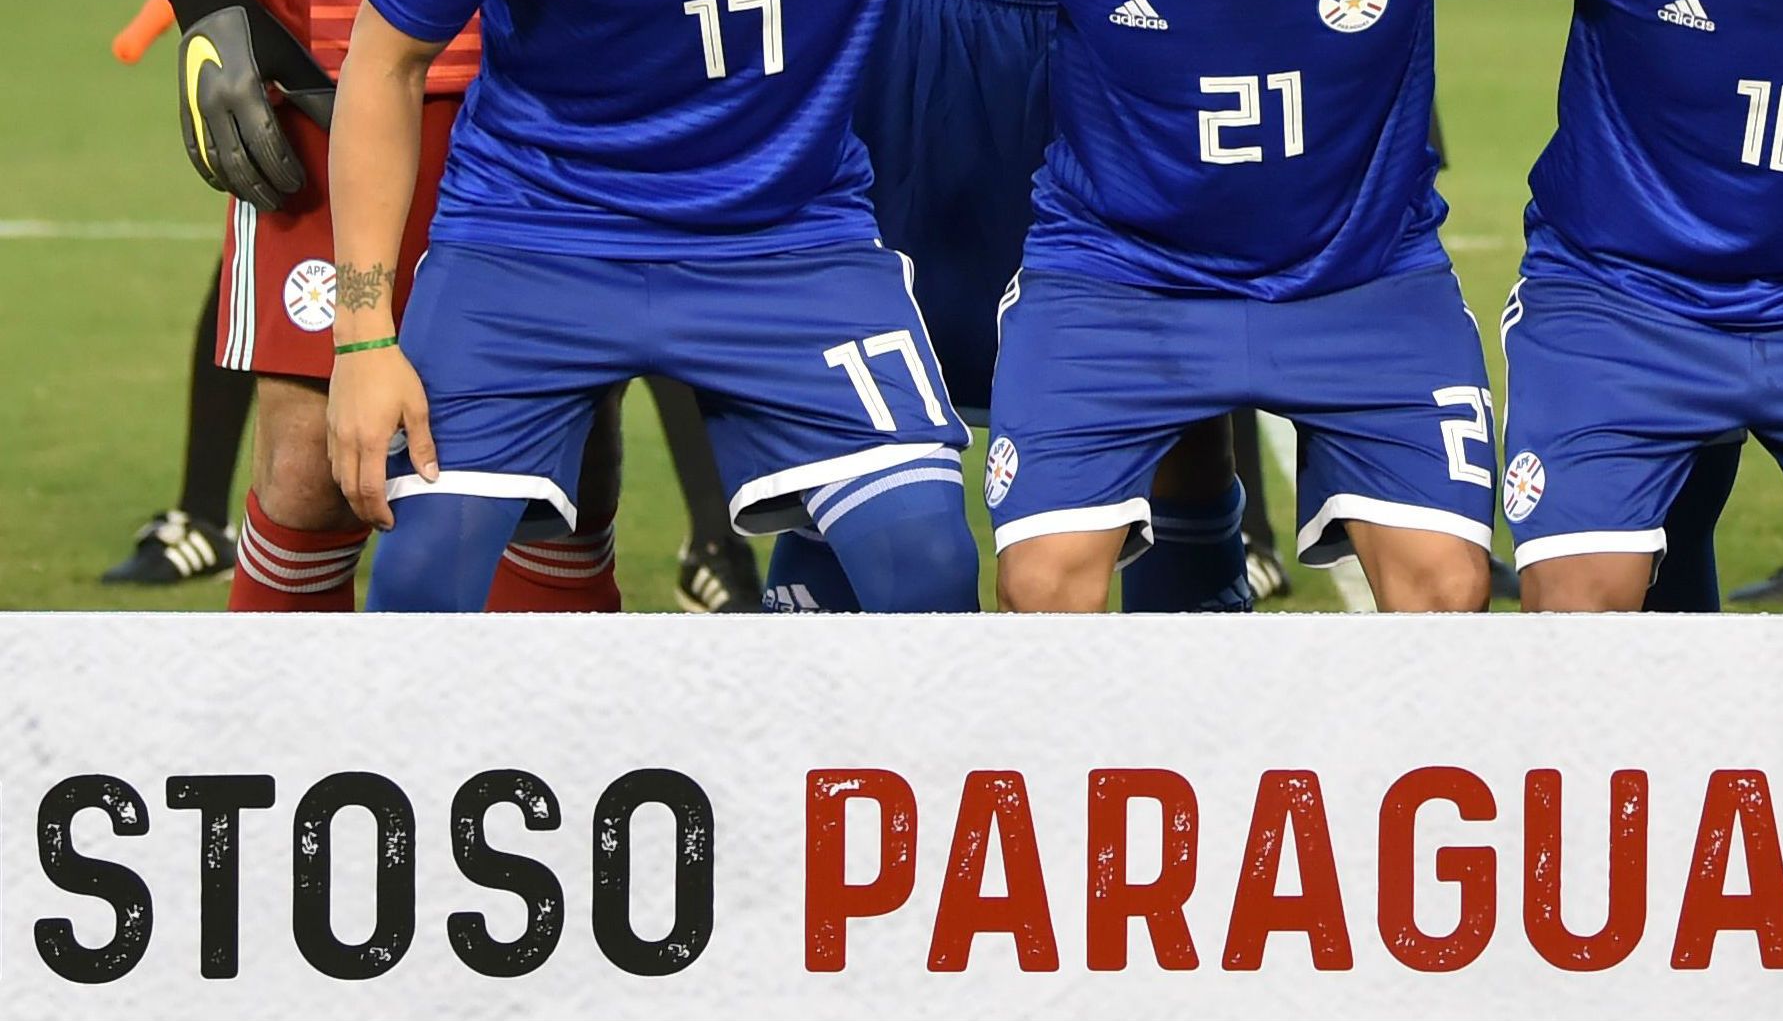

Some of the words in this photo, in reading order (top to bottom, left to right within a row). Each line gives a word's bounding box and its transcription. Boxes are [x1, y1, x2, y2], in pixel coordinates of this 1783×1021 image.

[1109, 13, 1169, 31] adidas
[1657, 9, 1716, 32] adidas
[1198, 70, 1304, 165] 21
[305, 265, 327, 277] APF
[822, 329, 949, 432] 17
[1432, 385, 1493, 489] 2
[34, 768, 715, 984] STOSO
